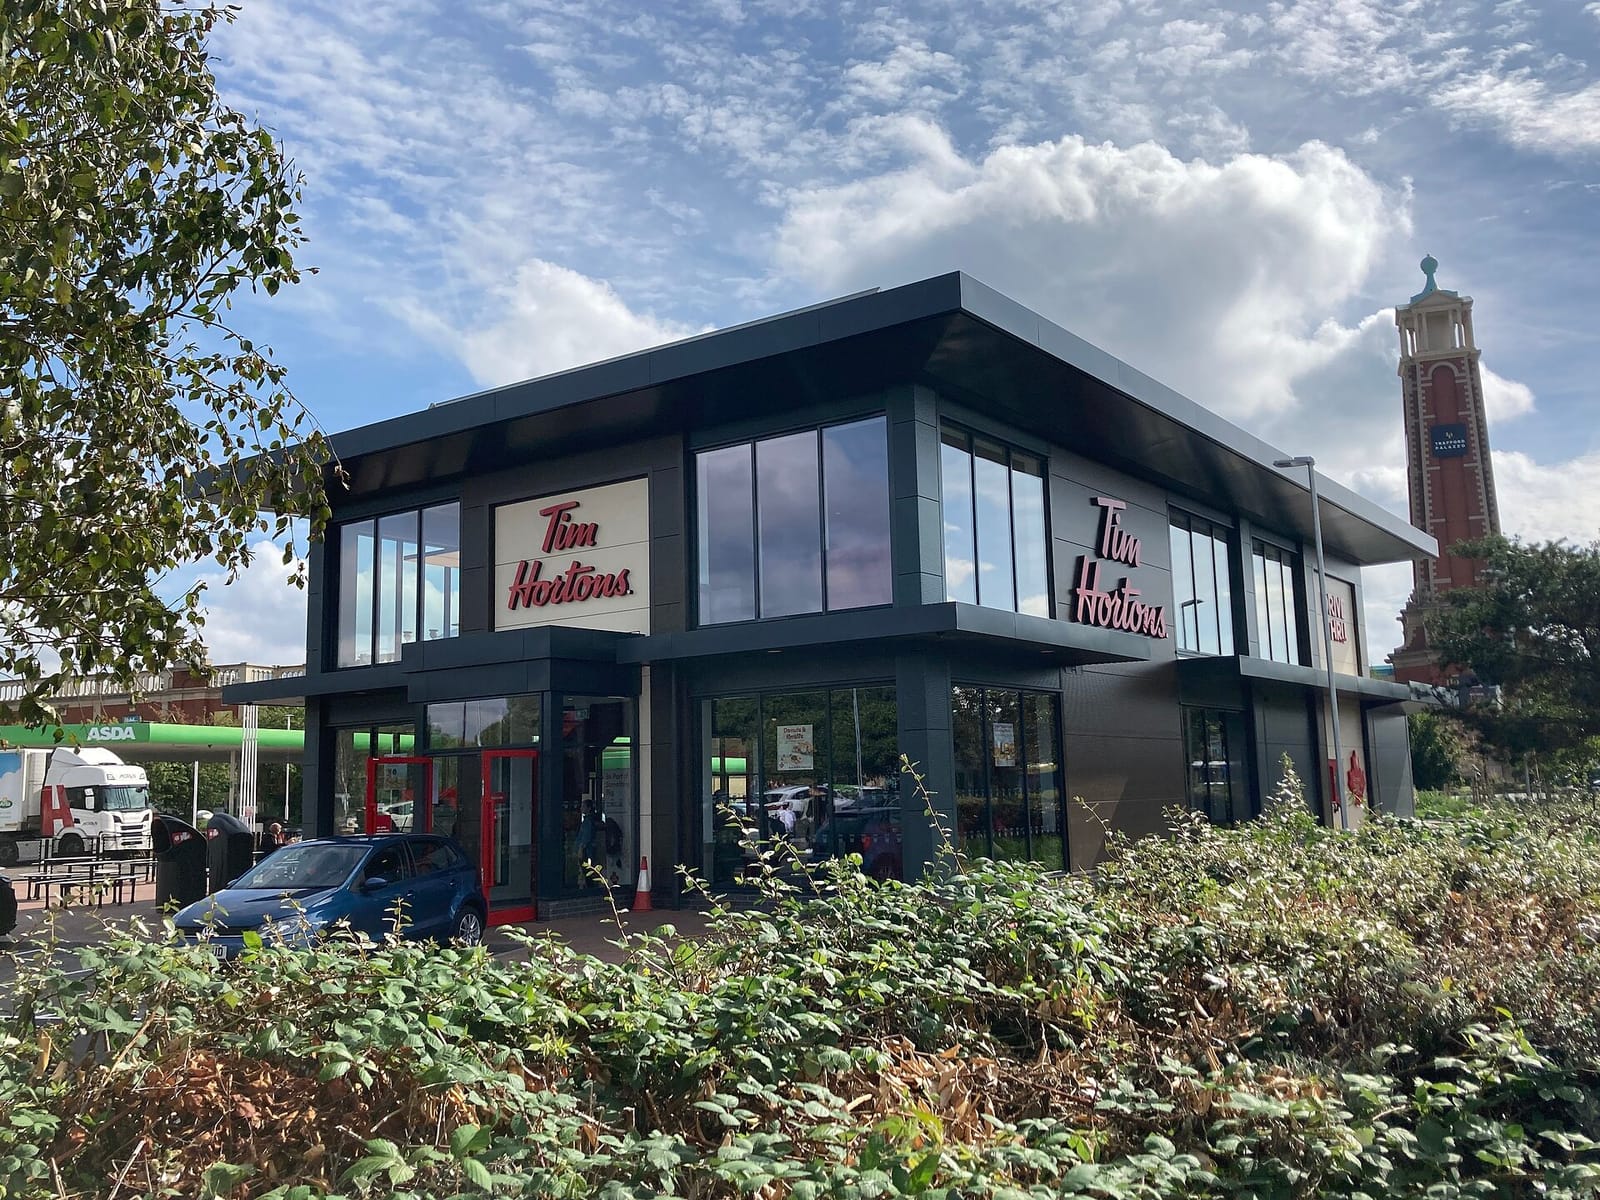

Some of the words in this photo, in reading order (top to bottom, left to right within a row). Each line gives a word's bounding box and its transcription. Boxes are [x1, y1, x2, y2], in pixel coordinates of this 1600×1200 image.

[538, 501, 598, 553] Tim
[1090, 496, 1141, 568] Tim
[87, 726, 136, 741] ASDA
